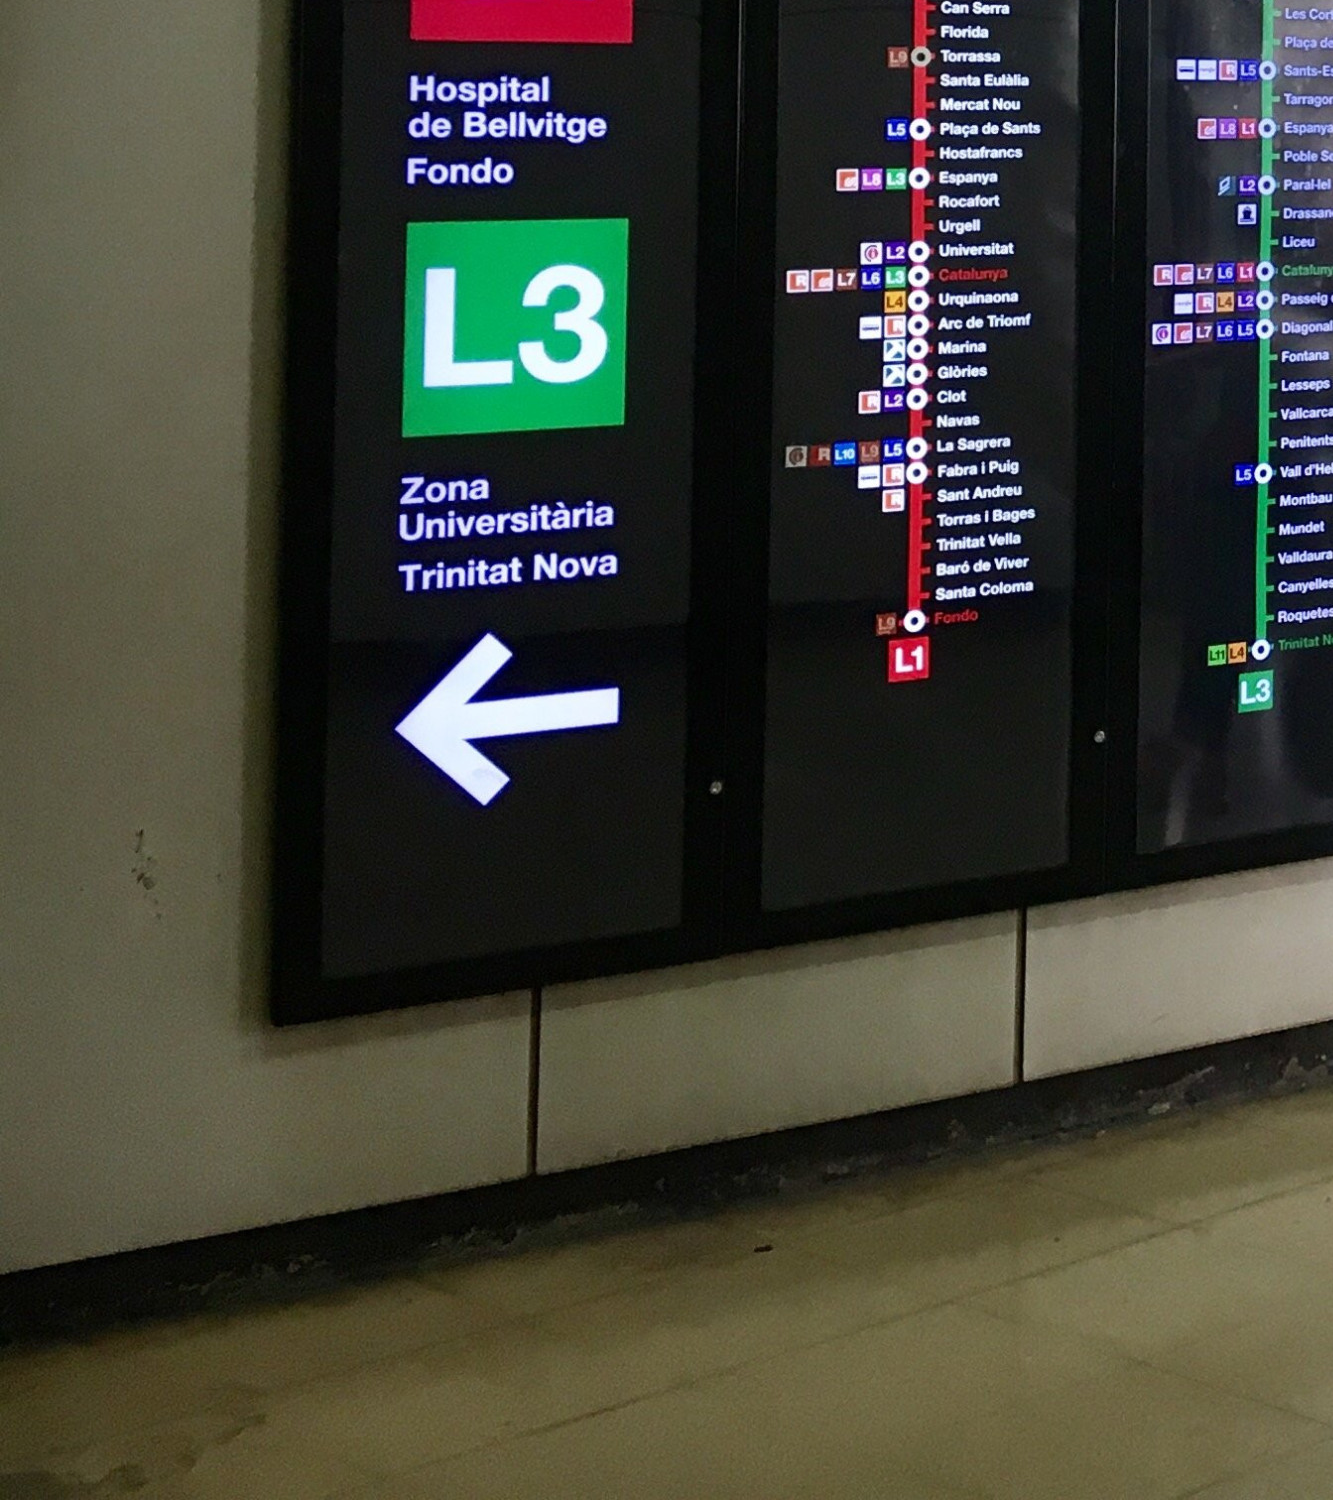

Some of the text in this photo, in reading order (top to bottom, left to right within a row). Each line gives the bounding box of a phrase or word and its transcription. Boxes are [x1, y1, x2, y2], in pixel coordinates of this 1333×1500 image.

[941, 2, 1010, 15] Can Serra
[1285, 9, 1305, 20] Les
[941, 26, 988, 39] Florida
[1285, 36, 1317, 50] Plaça
[940, 51, 1000, 63] Torrassa
[1241, 65, 1256, 75] L5
[940, 73, 1029, 86] Santa Eulàlia
[409, 76, 550, 107] Hospital
[940, 99, 1020, 111] Mercat Nou
[407, 111, 607, 143] de Bellvitge
[888, 124, 906, 137] L5
[940, 122, 1041, 137] Plaça de Sants
[1220, 123, 1236, 134] L8
[1242, 123, 1255, 134] L1
[1284, 122, 1333, 135] Espanya
[940, 147, 1023, 160] Hostafrancs
[1284, 151, 1318, 162] Poble
[406, 158, 514, 184] Fondo
[863, 173, 881, 186] L8
[887, 172, 905, 185] L3
[939, 172, 998, 185] Espanya
[1240, 180, 1255, 191] L2
[939, 196, 1000, 208] Rocafort
[939, 219, 980, 234] Urgell
[1282, 237, 1315, 248] Liceu
[887, 247, 904, 259] L2
[939, 243, 1014, 257] Universitat
[837, 272, 855, 286] L7
[862, 272, 880, 284] L6
[887, 271, 904, 283] L3
[939, 268, 1008, 283] Catalunya
[1197, 268, 1212, 280] L7
[1218, 267, 1233, 279] L6
[1240, 267, 1253, 278] L1
[887, 295, 903, 308] L4
[939, 292, 1018, 307] Urquinaona
[1218, 296, 1232, 307] L4
[1238, 295, 1253, 306] L2
[1282, 293, 1327, 307] Passeig
[422, 264, 608, 388] L3
[938, 313, 1030, 330] Arc de Triomf
[1282, 320, 1333, 335] Diagonal
[1197, 326, 1212, 337] L7
[1218, 326, 1232, 336] L6
[1238, 325, 1253, 336] L5
[938, 341, 986, 354] Marina
[1282, 350, 1329, 362] Fontana
[938, 365, 987, 379] Glòries
[1281, 379, 1330, 392] Lesseps
[885, 394, 903, 407] L2
[937, 391, 966, 403] Clot
[937, 415, 980, 428] Navas
[885, 444, 902, 457] L5
[937, 437, 1010, 452] La Sagrera
[835, 448, 855, 460] L10
[938, 464, 977, 478] Fabra
[989, 461, 1019, 475] Puig
[1236, 469, 1251, 481] L5
[1280, 465, 1301, 478] Vall
[400, 479, 489, 503] Zona
[937, 485, 1022, 502] Sant Andreu
[1280, 493, 1332, 506] Montbau
[398, 501, 615, 542] Universitària
[937, 513, 980, 527] Torras
[993, 508, 1035, 525] Bages
[1279, 521, 1324, 535] Mundet
[937, 533, 1021, 551] Trinitat Vella
[1278, 549, 1333, 564] Valldaura
[398, 551, 618, 592] Trinitat Nova
[936, 557, 1029, 575] Baró de Viver
[936, 581, 1033, 601] Santa Coloma
[934, 610, 978, 624] Fondo
[878, 618, 895, 631] L9
[1278, 637, 1320, 651] Trinitat
[896, 646, 923, 673] L1
[1230, 647, 1244, 659] L4
[1241, 680, 1271, 705] L3
